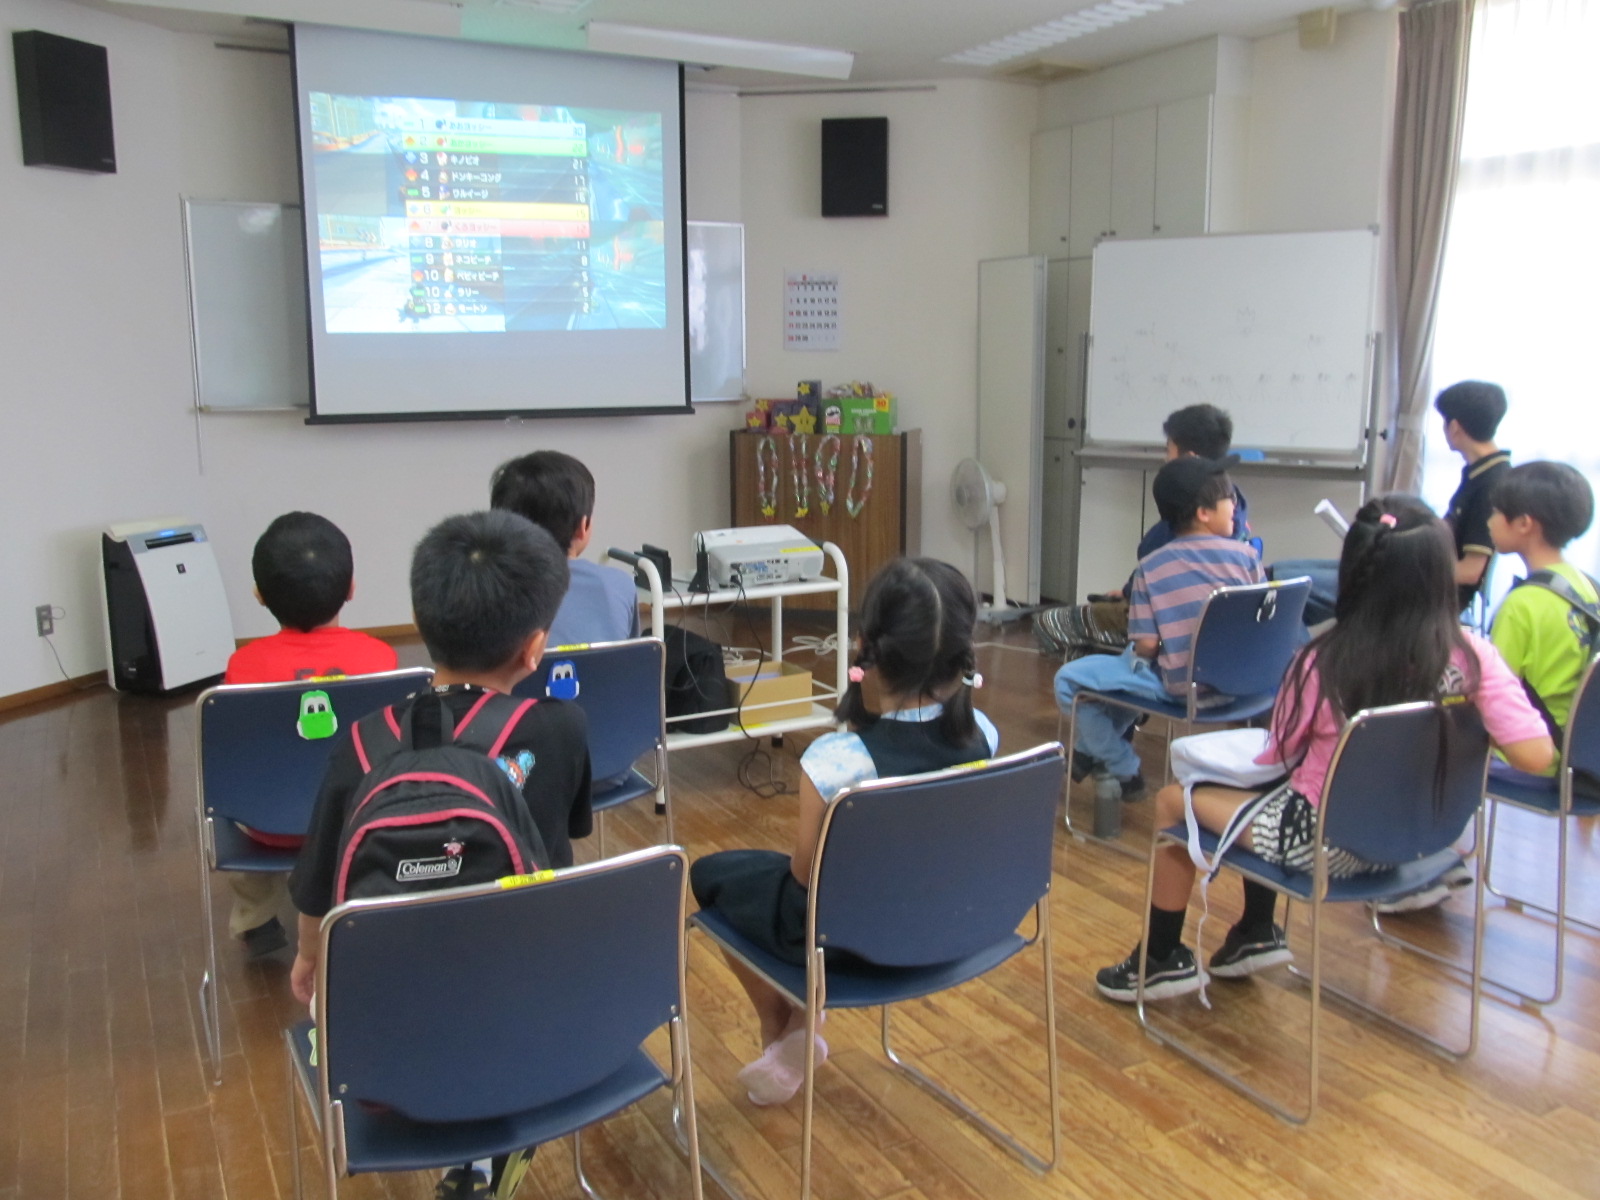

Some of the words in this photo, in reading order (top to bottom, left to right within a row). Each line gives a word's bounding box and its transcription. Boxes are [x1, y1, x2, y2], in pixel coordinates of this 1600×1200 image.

[419, 152, 429, 164] 3
[420, 169, 429, 181] 4
[451, 171, 502, 183] ドンキーコング
[421, 186, 430, 198] 5
[452, 188, 489, 200] ワルイージ
[425, 237, 434, 248] 8
[576, 240, 586, 251] 11
[425, 254, 434, 264] 9
[424, 270, 439, 281] 10
[425, 286, 440, 298] 10
[426, 302, 441, 315] 12
[402, 860, 447, 875] Coleman
